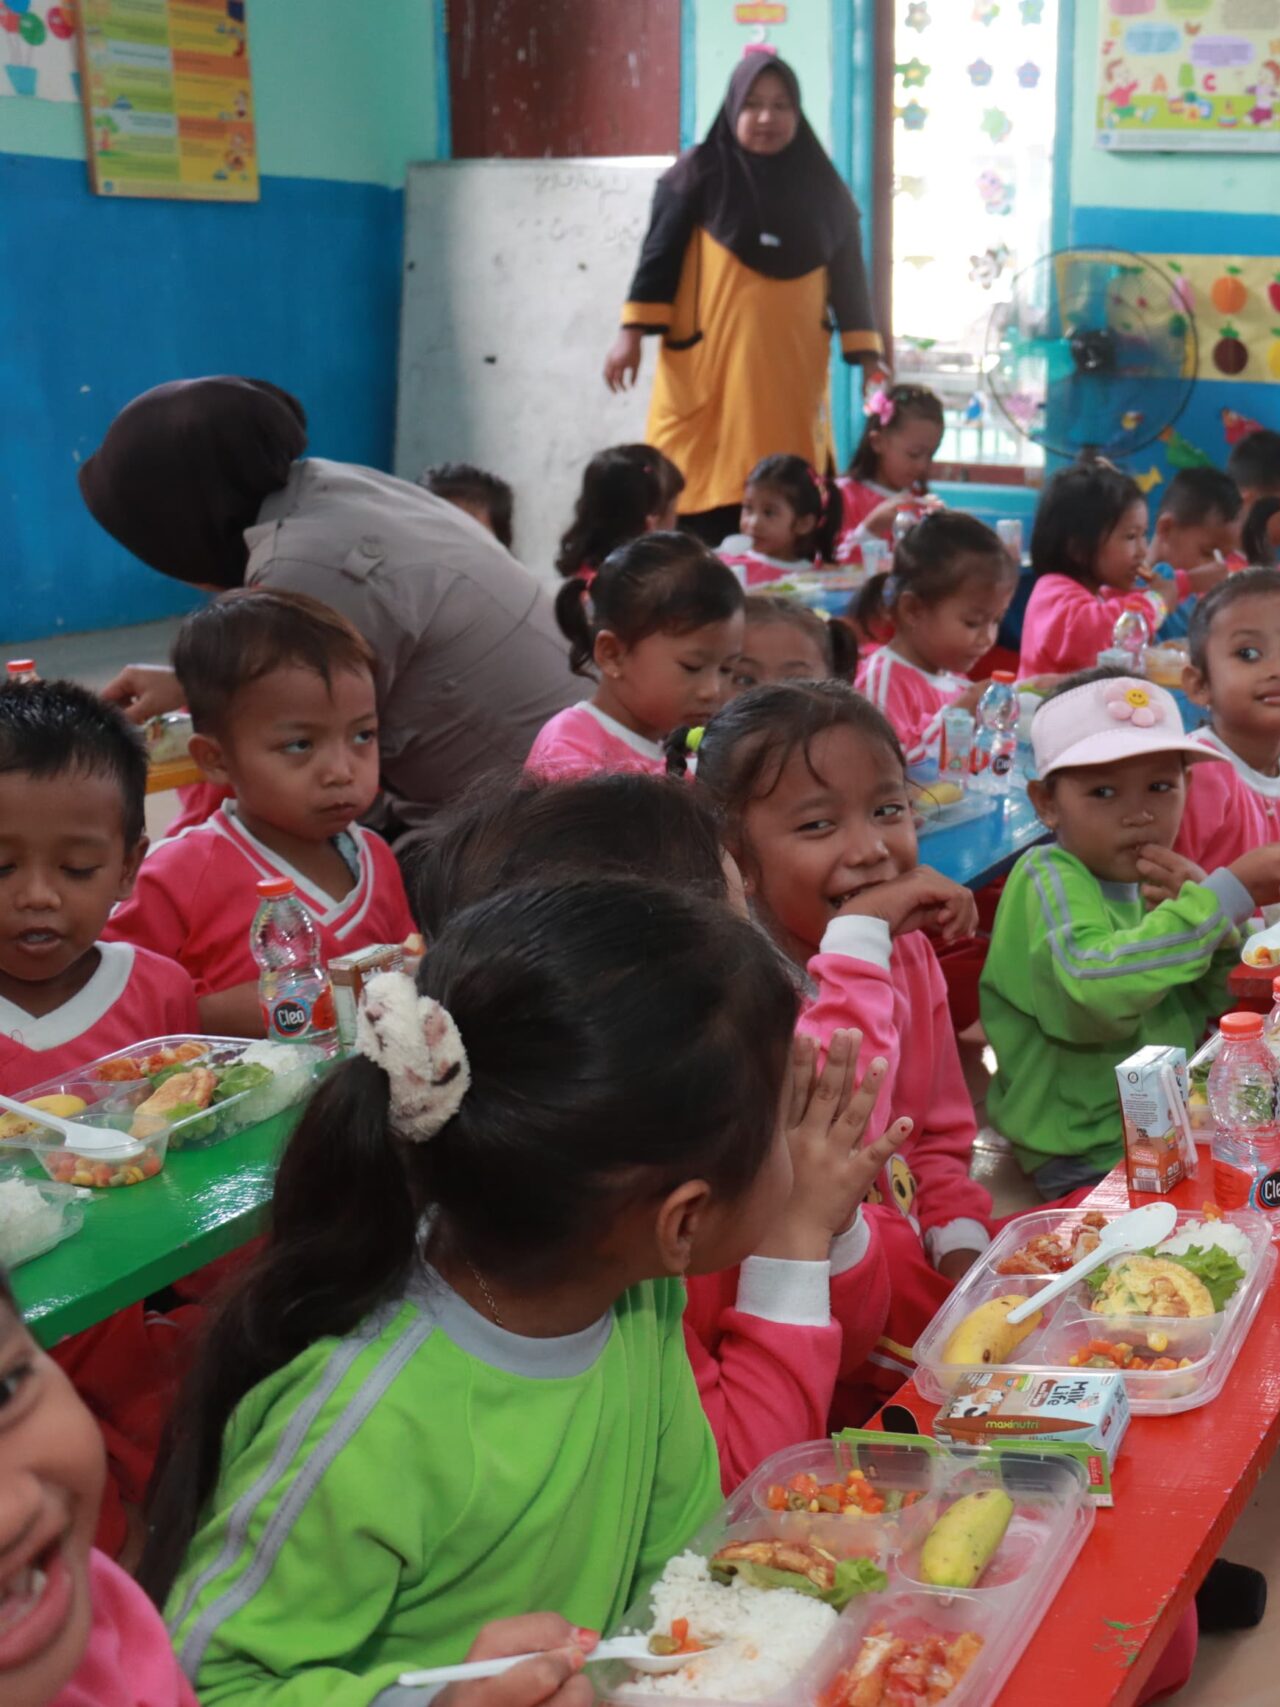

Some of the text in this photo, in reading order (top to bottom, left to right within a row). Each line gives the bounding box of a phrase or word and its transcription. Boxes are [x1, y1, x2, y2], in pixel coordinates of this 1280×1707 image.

[277, 1009, 305, 1026] Cleo
[1046, 1384, 1068, 1406] Life
[1063, 1380, 1089, 1405] Milk
[985, 1420, 1039, 1430] maxinutri
